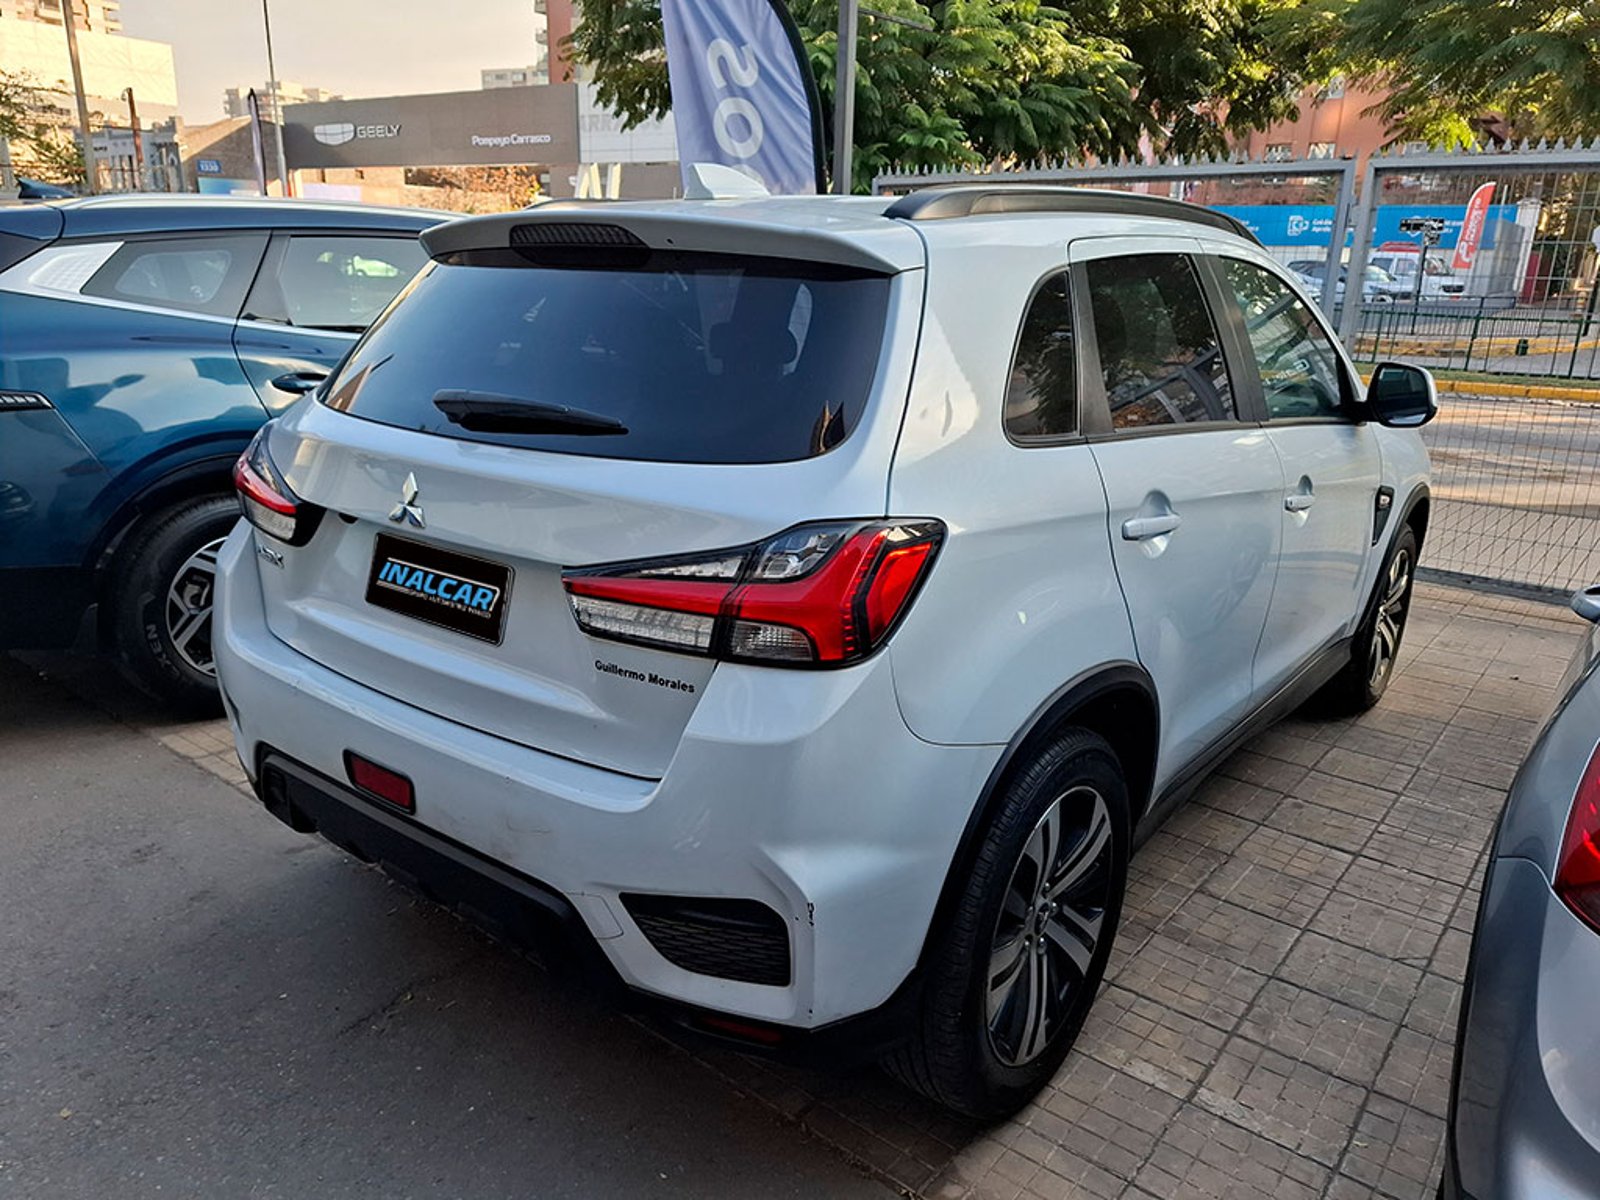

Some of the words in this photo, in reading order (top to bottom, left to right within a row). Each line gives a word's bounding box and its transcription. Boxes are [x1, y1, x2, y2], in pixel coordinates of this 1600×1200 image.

[357, 124, 401, 138] GEELY
[471, 135, 510, 147] Pompeyo
[510, 133, 551, 144] Carrasco
[379, 561, 494, 611] INALCAR
[595, 660, 646, 682] Guillermo
[648, 673, 695, 693] Morales
